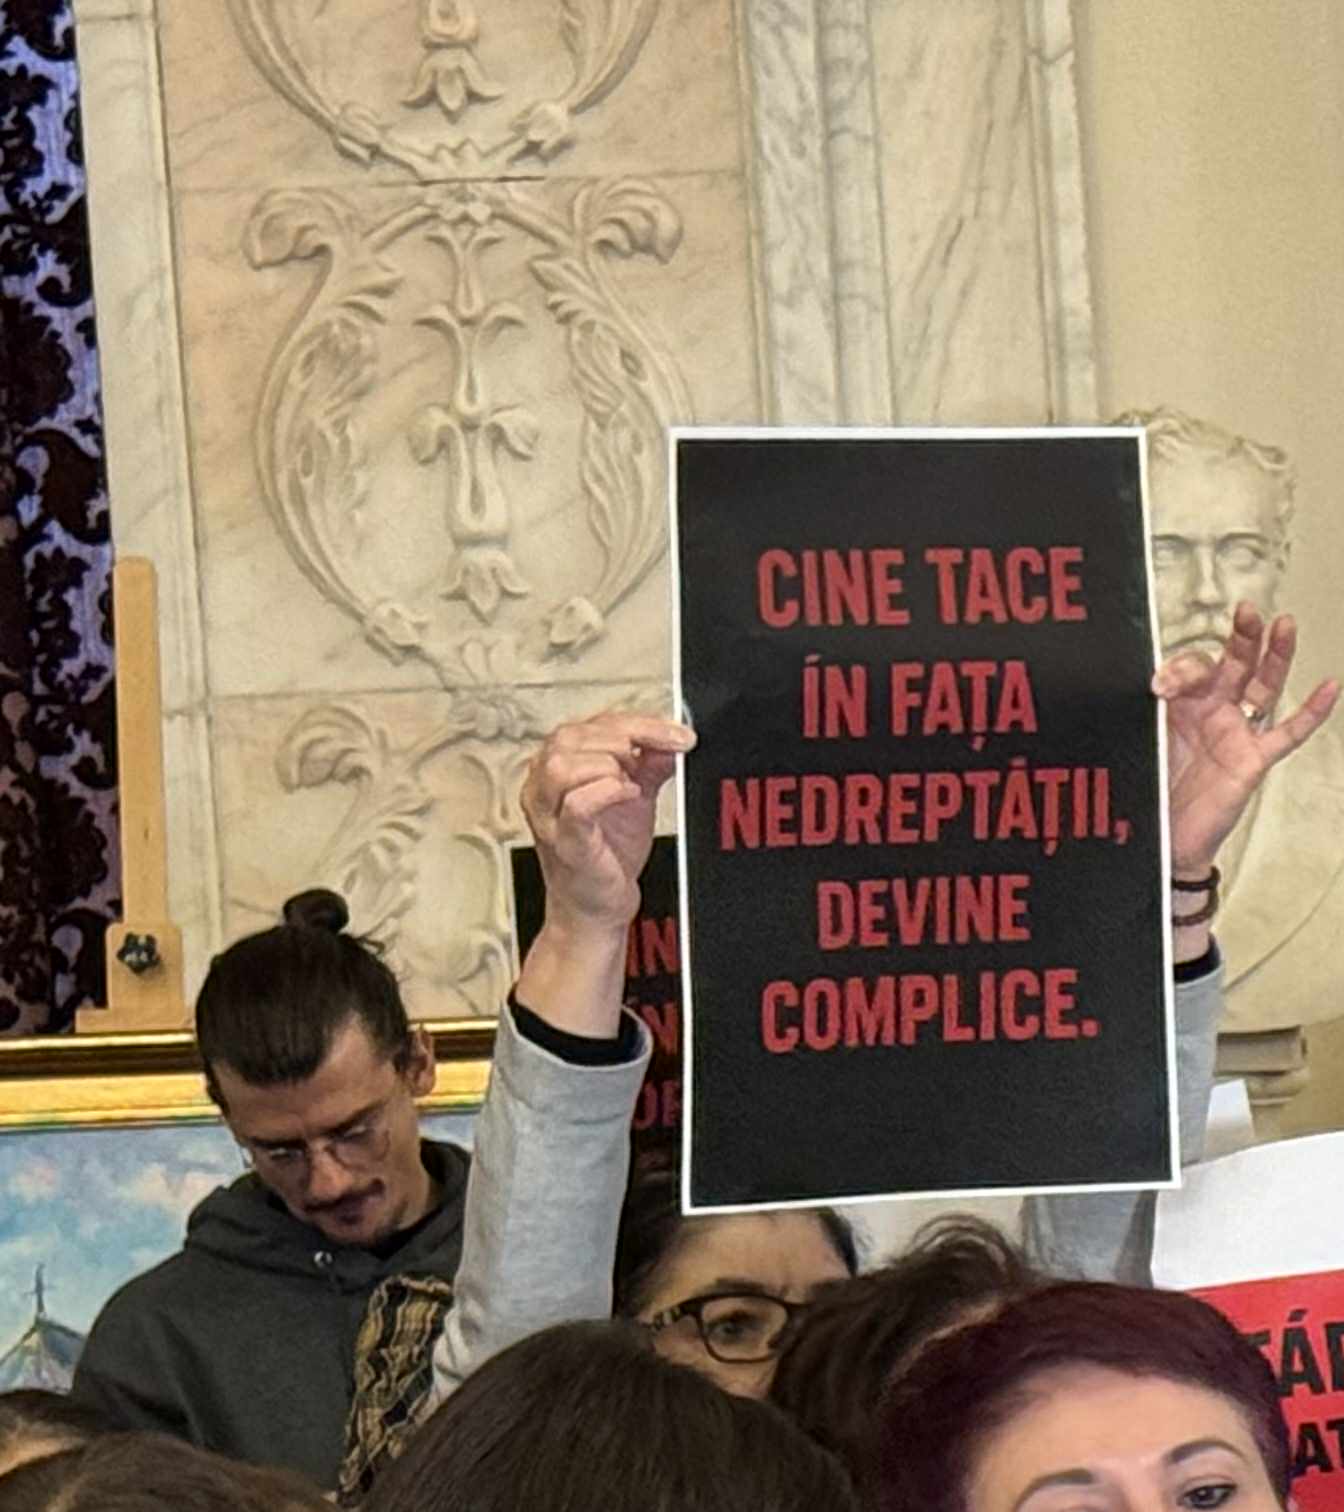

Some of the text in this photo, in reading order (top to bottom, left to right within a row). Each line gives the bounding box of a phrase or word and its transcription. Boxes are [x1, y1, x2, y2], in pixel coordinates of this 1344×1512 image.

[757, 547, 1087, 627] CINE TACE
[816, 874, 1031, 950] DEVINE
[761, 969, 1100, 1054] COMPLICE.
